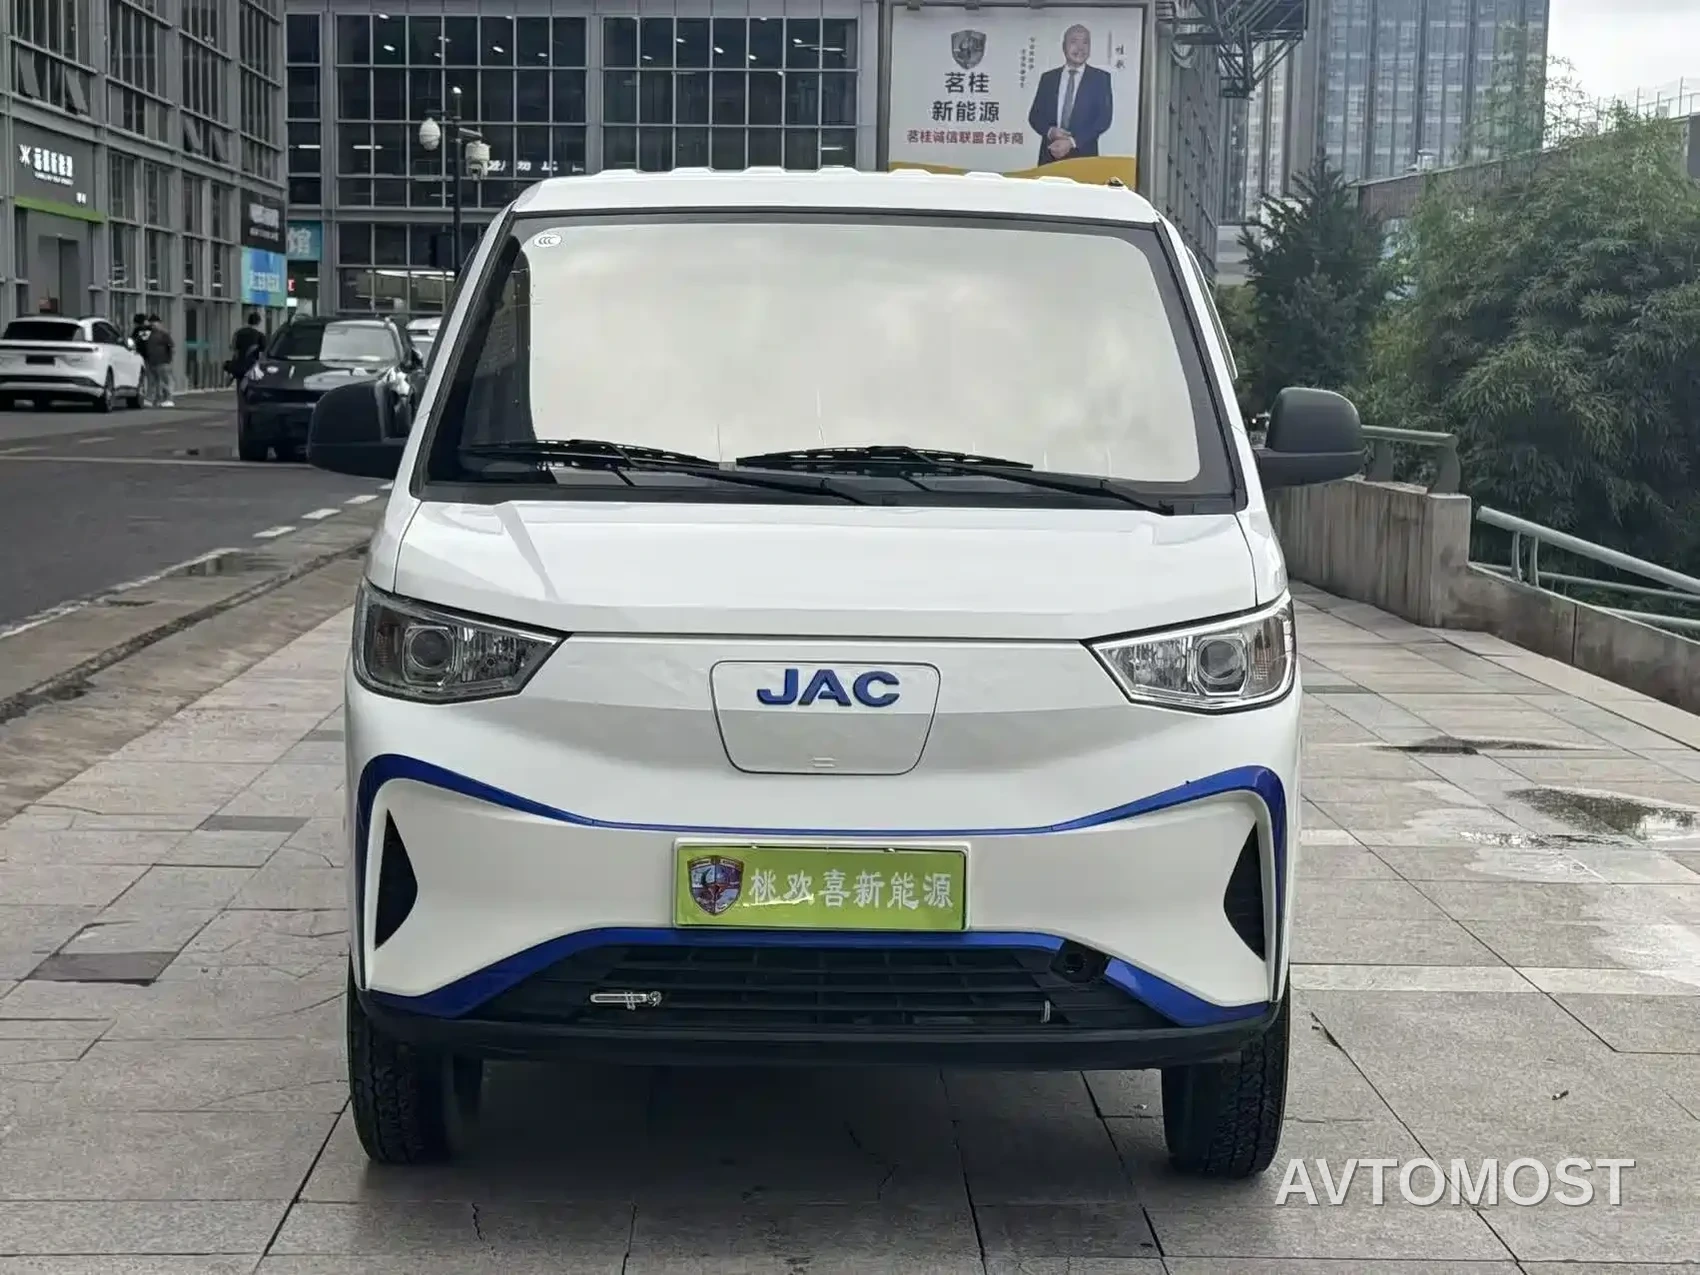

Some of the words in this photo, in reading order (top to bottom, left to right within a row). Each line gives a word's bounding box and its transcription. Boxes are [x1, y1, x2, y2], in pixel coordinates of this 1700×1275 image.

[944, 72, 990, 94] 茗桂
[932, 100, 1000, 122] 新能源
[907, 129, 1024, 145] 茗桂诚信联盟合作商
[757, 668, 900, 707] JAC
[748, 868, 954, 910] 桃欢喜新能源
